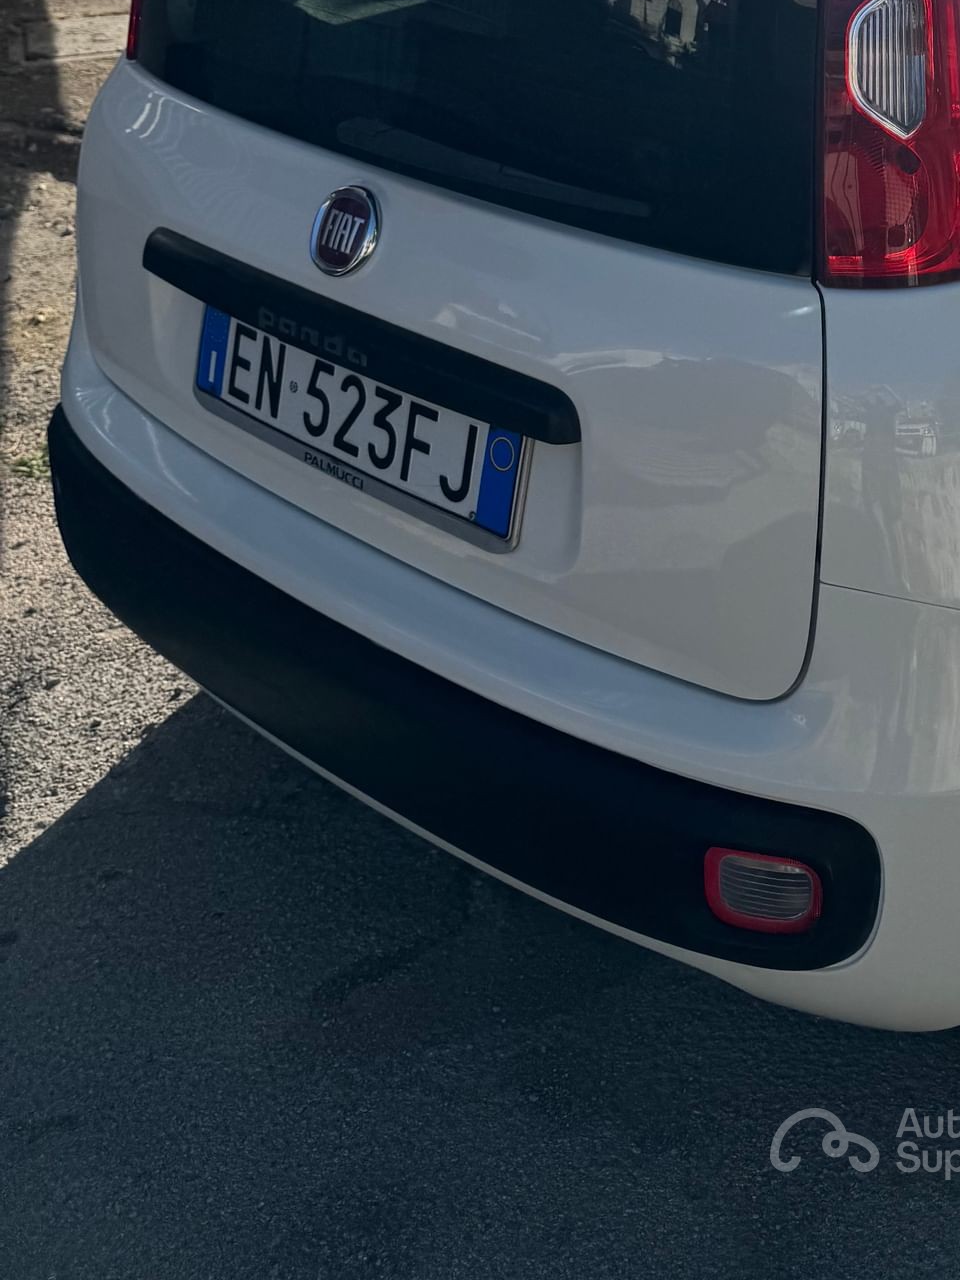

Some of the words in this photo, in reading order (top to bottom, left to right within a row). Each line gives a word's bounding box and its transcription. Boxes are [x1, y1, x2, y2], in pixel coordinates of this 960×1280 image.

[321, 208, 366, 255] FIAT
[257, 305, 369, 369] panda
[227, 321, 287, 420] EN
[302, 358, 479, 504] 523FJ
[303, 451, 365, 490] PALMUCCI
